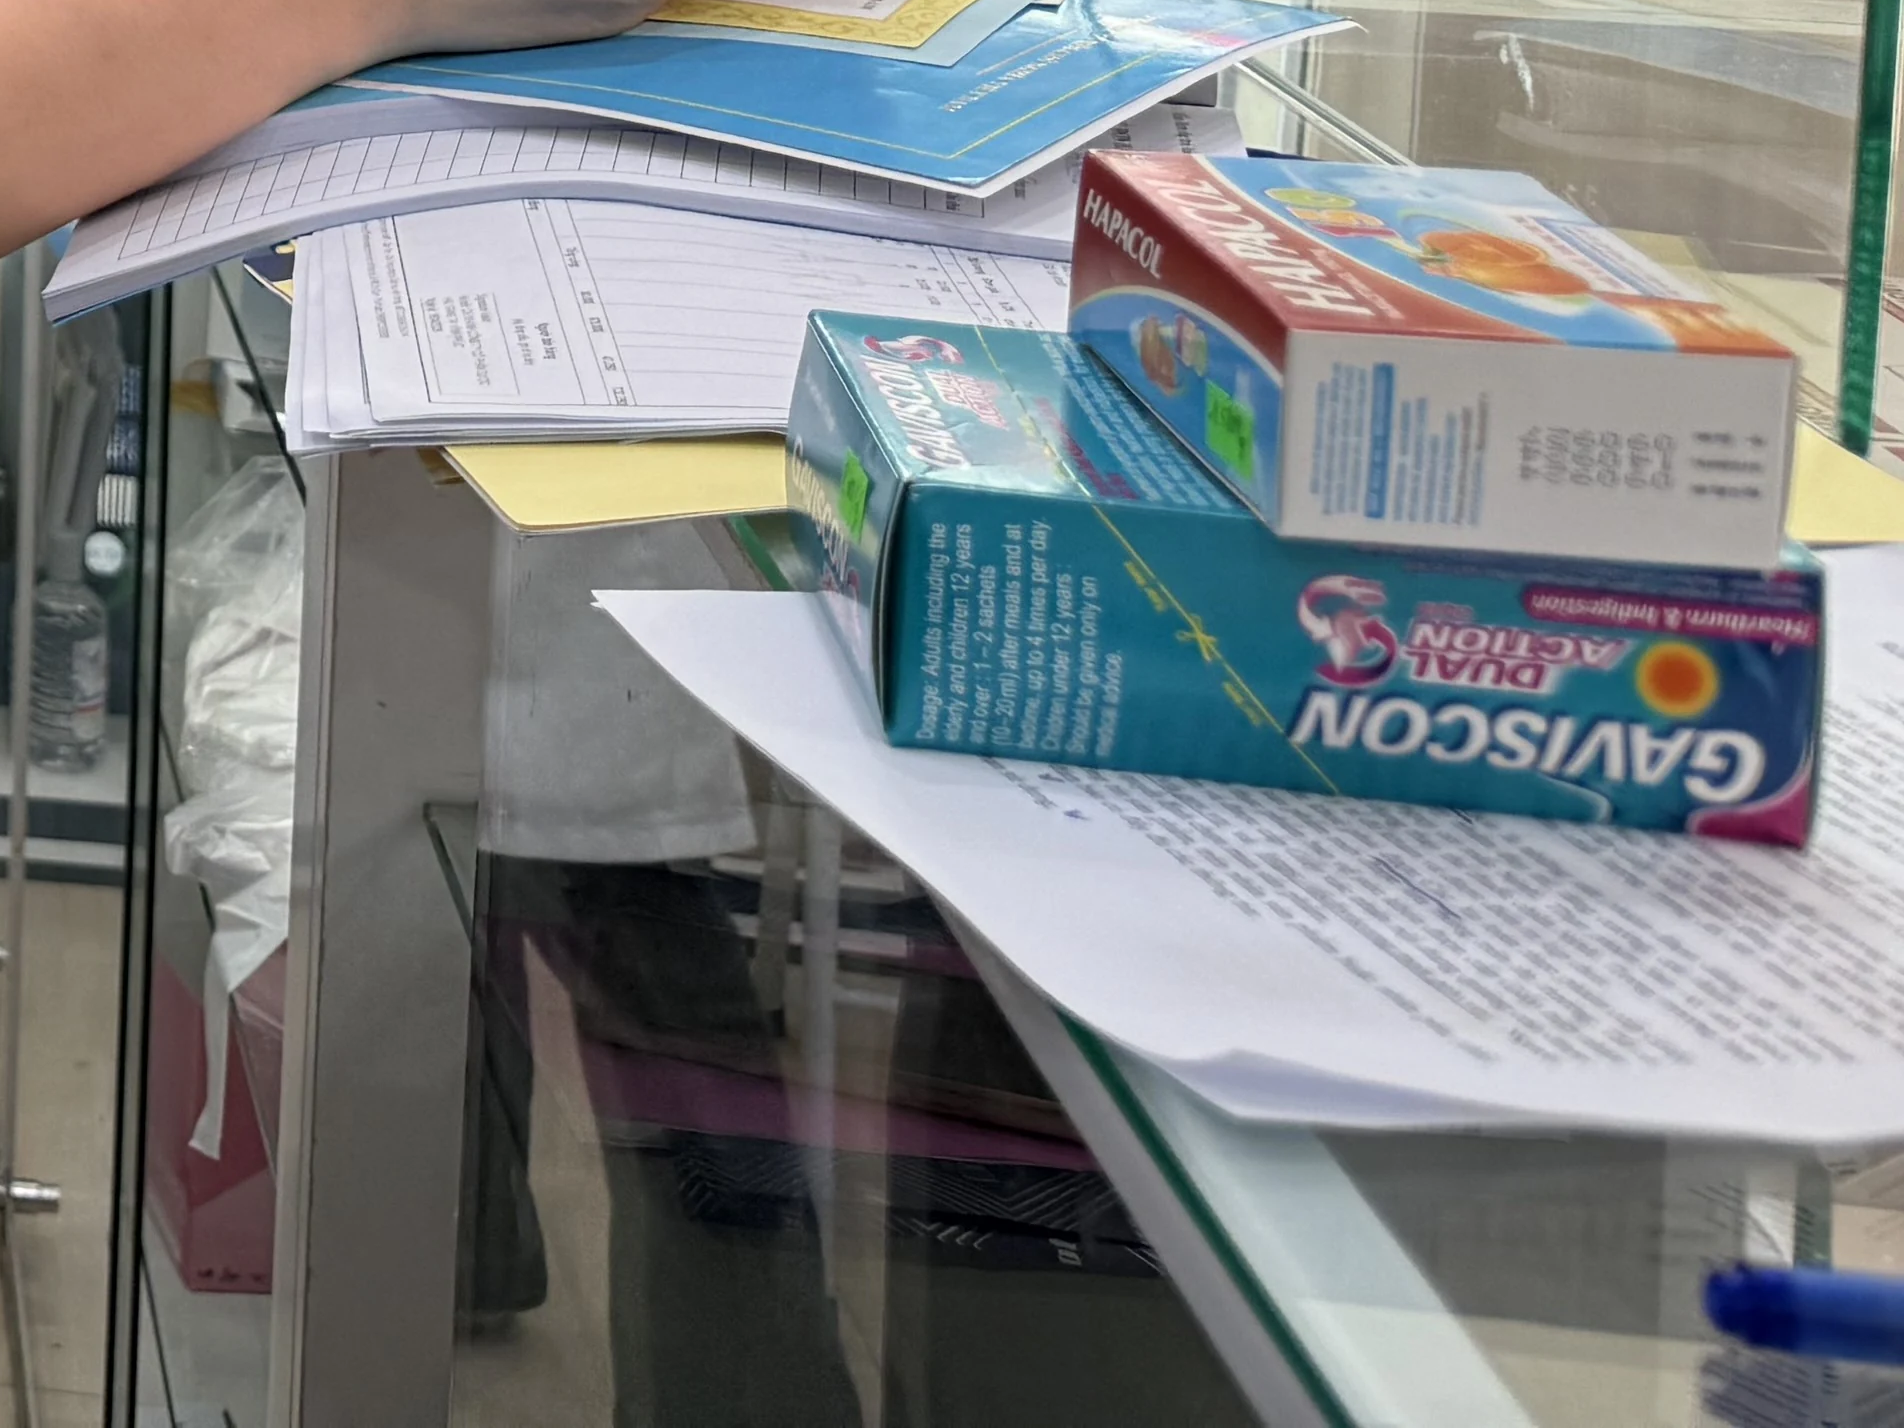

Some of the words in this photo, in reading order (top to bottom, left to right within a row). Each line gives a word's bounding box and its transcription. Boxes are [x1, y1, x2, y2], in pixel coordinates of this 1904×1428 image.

[1082, 187, 1164, 281] HAPACOL
[1152, 179, 1373, 318] HAPACOL
[859, 354, 972, 471] GAVISCON
[927, 523, 946, 549] the
[954, 523, 975, 570] years
[1006, 524, 1022, 541] at
[951, 573, 970, 592] 12
[1005, 545, 1021, 577] and
[1030, 557, 1052, 584] per
[924, 553, 950, 623] including
[977, 565, 996, 629] sachets
[1004, 580, 1021, 630] meals
[1055, 573, 1076, 619] years
[1081, 576, 1099, 598] on
[1531, 590, 1659, 627] Indigestion
[950, 597, 969, 661] children
[1028, 587, 1048, 632] times
[1080, 601, 1103, 638] only
[921, 627, 942, 677] Adults
[973, 632, 994, 643] 2
[1000, 634, 1018, 670] after
[1051, 623, 1071, 642] 12
[1409, 622, 1624, 665] ACTION
[948, 664, 966, 695] and
[1027, 650, 1044, 666] to
[1049, 649, 1070, 695] under
[1078, 640, 1099, 685] given
[1405, 649, 1550, 692] DUAL
[973, 685, 989, 717] over
[1025, 670, 1047, 691] up
[1073, 688, 1093, 706] be
[1040, 696, 1065, 750] Children
[1292, 690, 1766, 804] GAVISCON
